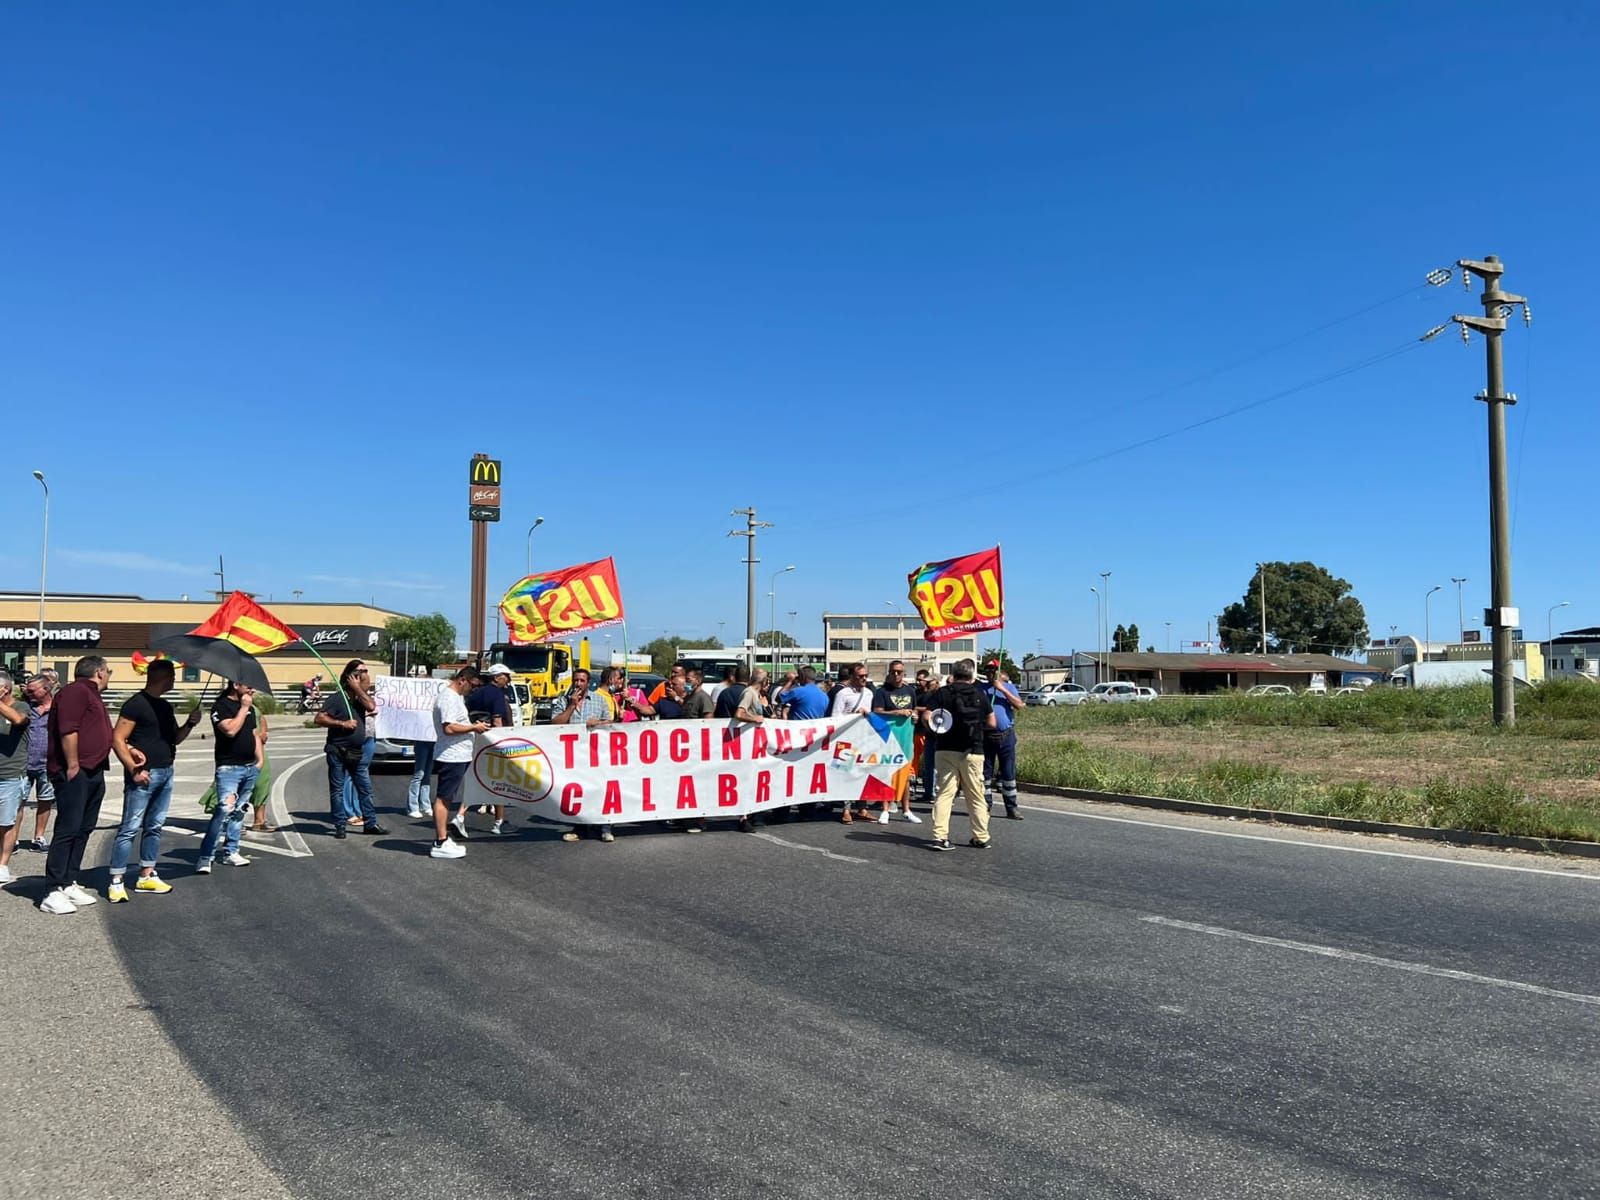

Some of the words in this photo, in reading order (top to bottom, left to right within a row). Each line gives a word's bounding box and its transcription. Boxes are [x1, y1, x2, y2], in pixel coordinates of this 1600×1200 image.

[0, 627, 101, 641] McDonald's
[560, 725, 836, 769] TIROCINANTI
[487, 755, 542, 791] USB
[561, 764, 828, 816] CALABRIA
